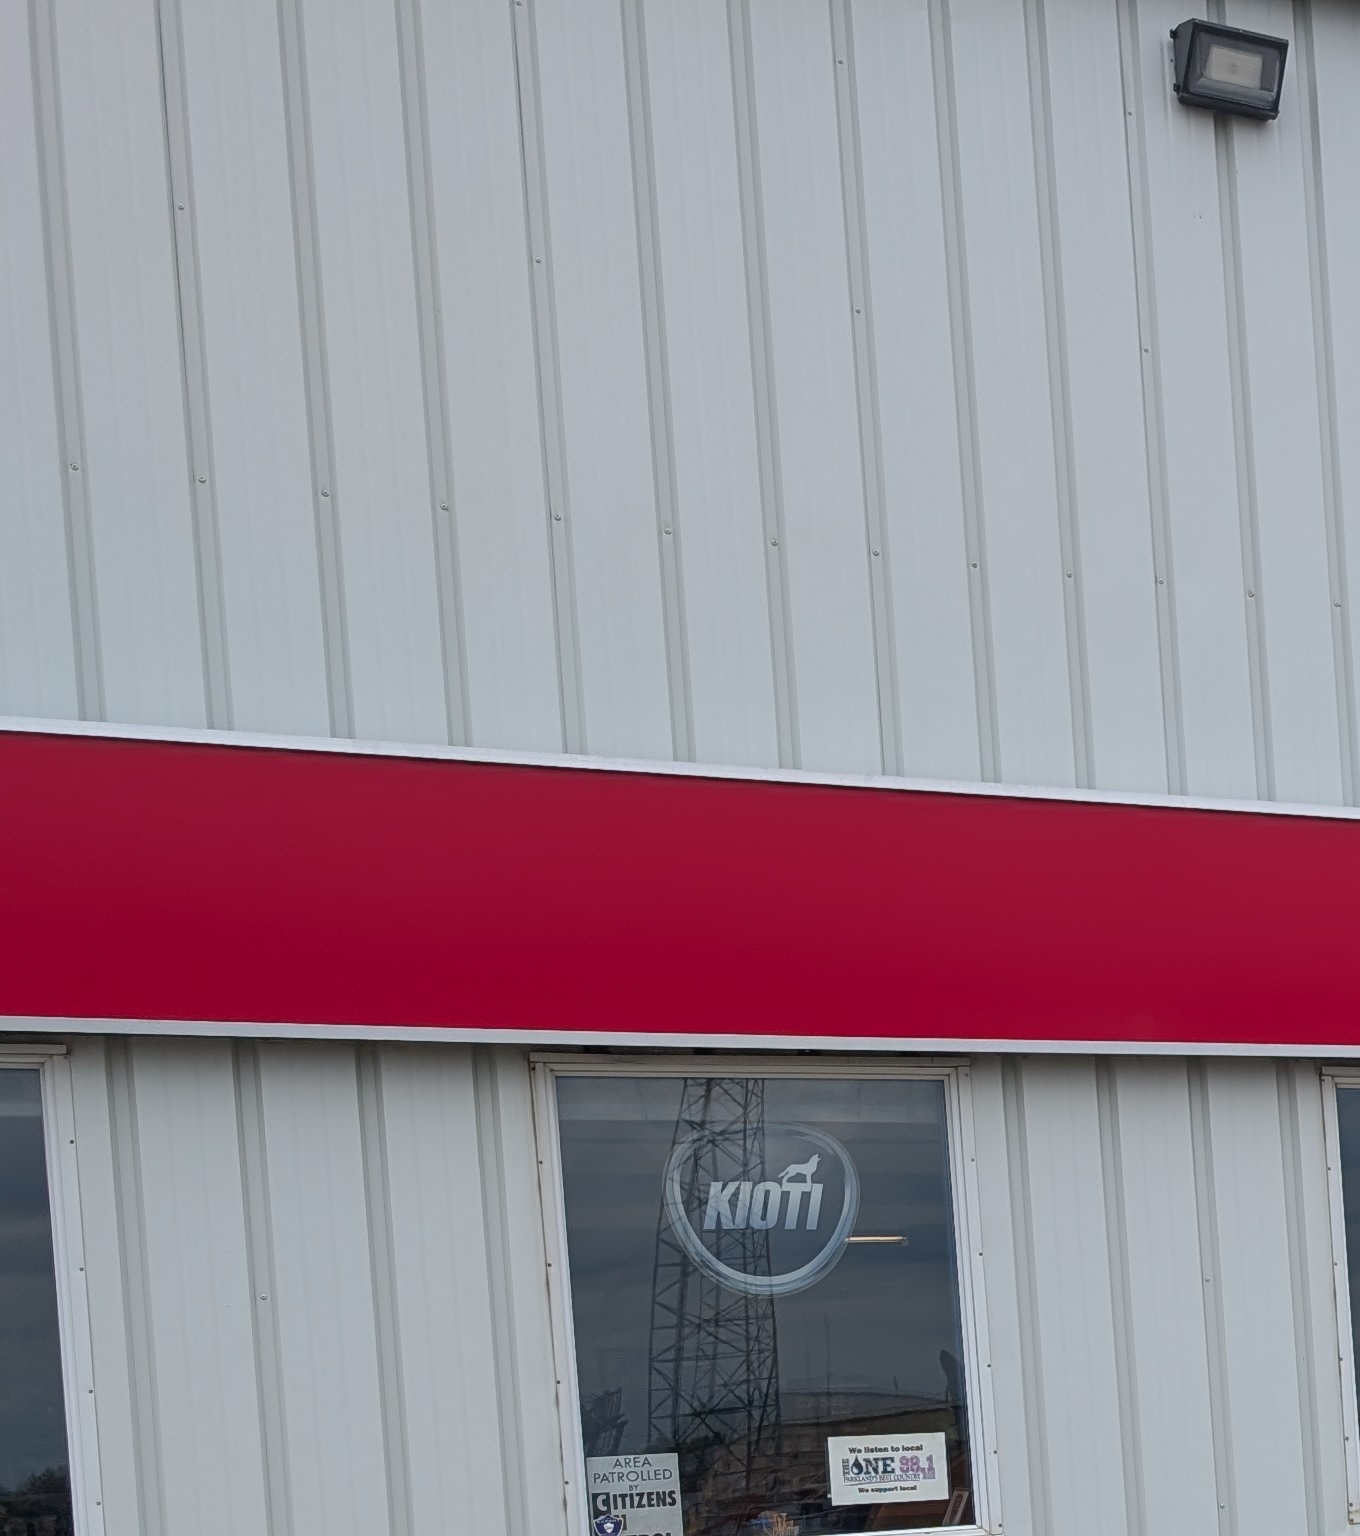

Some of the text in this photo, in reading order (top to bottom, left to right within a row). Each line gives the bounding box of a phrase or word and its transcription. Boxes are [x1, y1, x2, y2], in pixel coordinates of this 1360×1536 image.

[703, 1181, 824, 1230] KIOTI
[848, 1446, 862, 1455] We
[902, 1444, 923, 1452] local
[613, 1457, 652, 1469] AREA
[593, 1469, 673, 1484] PATROLLED
[628, 1484, 639, 1492] BY
[594, 1490, 677, 1512] CITIZENS
